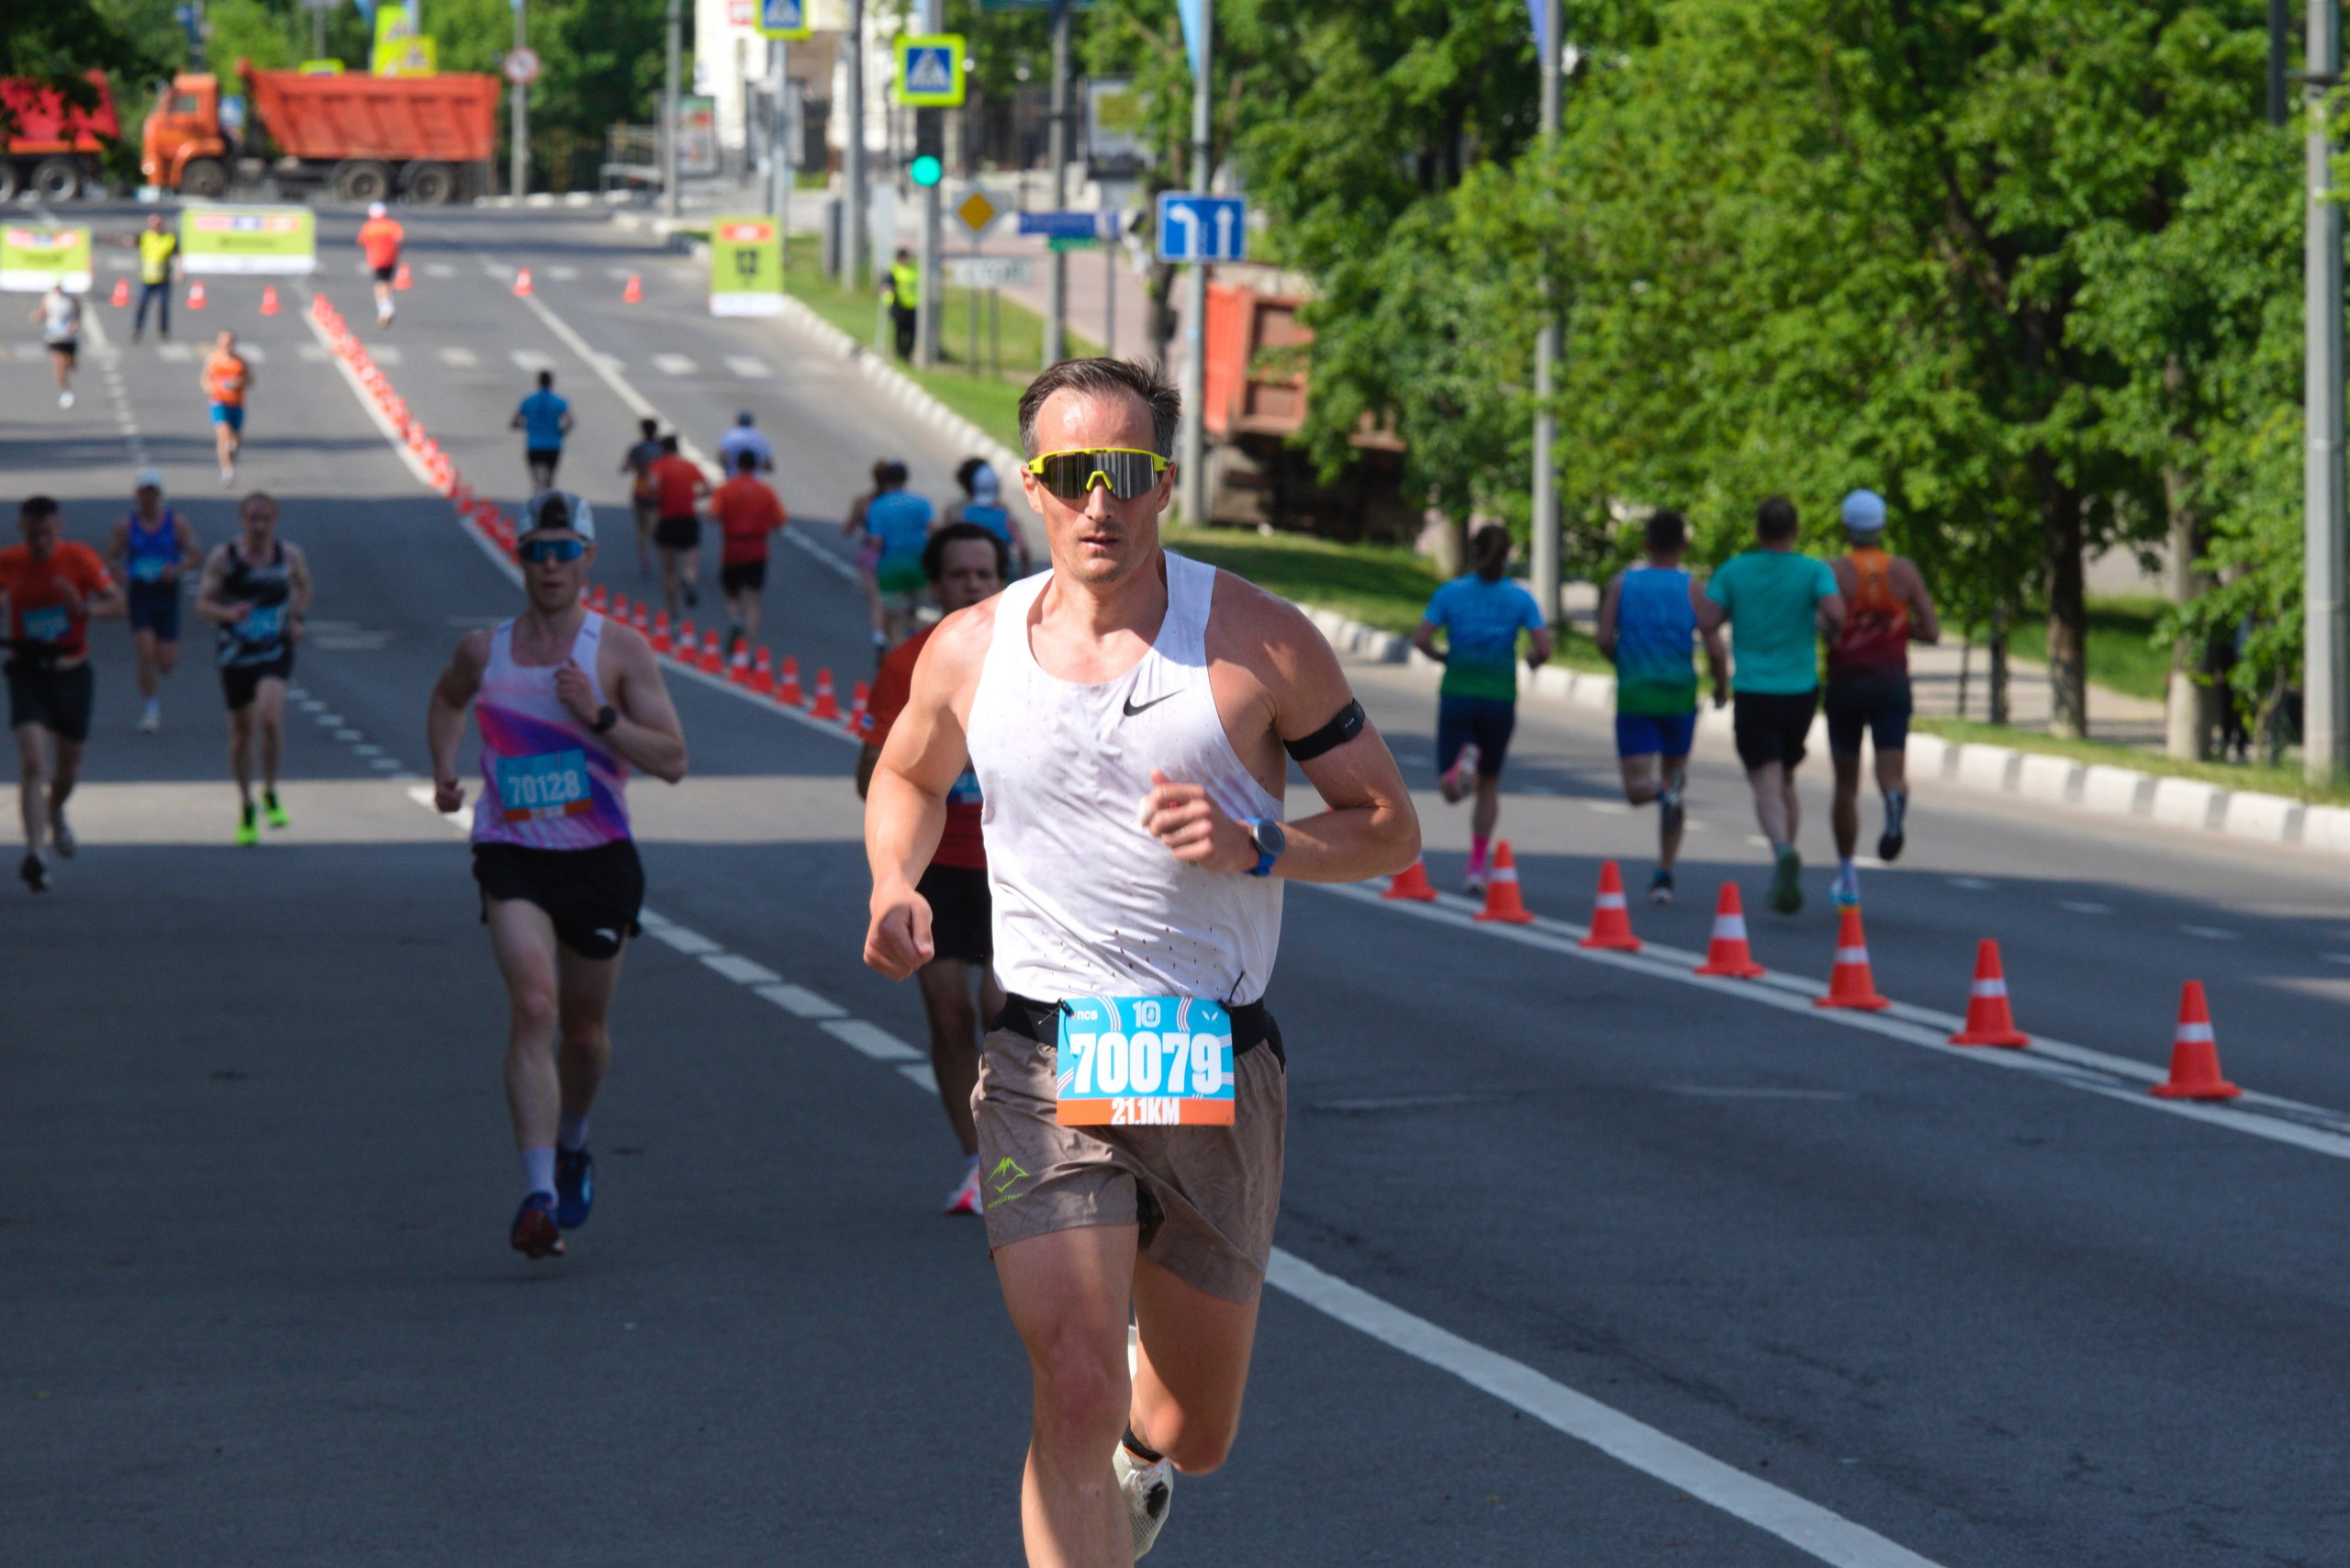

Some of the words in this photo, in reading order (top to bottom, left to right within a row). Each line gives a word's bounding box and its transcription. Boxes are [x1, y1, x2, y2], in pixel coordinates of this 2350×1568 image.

[508, 769, 581, 805] 70128
[1076, 1010, 1098, 1021] ПСБ
[1132, 1000, 1161, 1028] 10
[1069, 1031, 1223, 1094] 70079
[1110, 1096, 1181, 1126] 21.1KM
